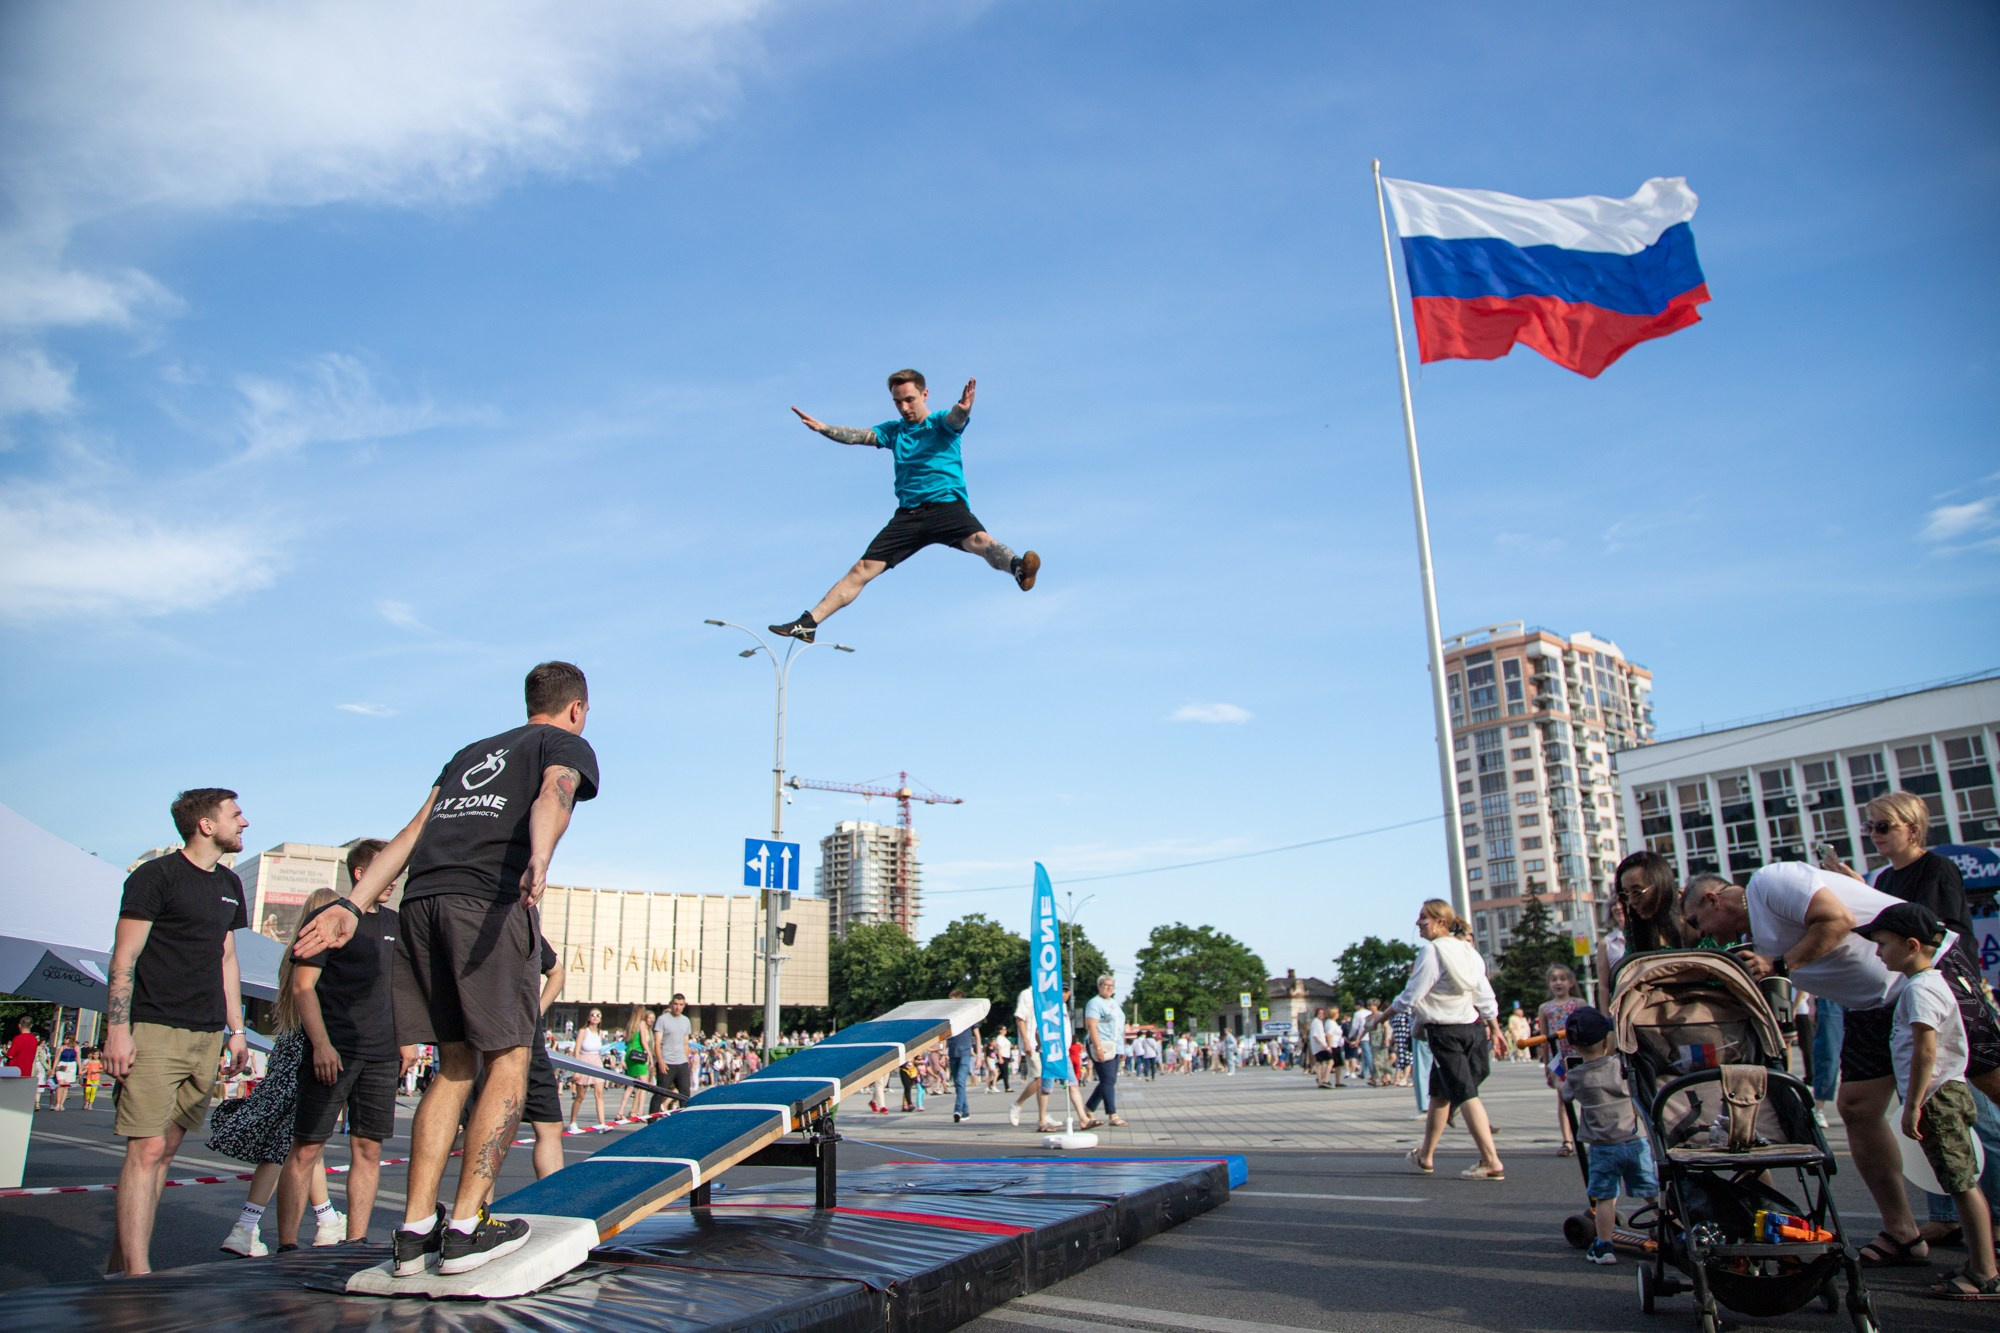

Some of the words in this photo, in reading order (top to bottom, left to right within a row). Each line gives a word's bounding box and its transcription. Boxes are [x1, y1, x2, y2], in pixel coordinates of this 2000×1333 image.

[433, 797, 456, 815] FLY
[454, 794, 508, 811] ZONE
[570, 944, 696, 973] ДРАМЫ
